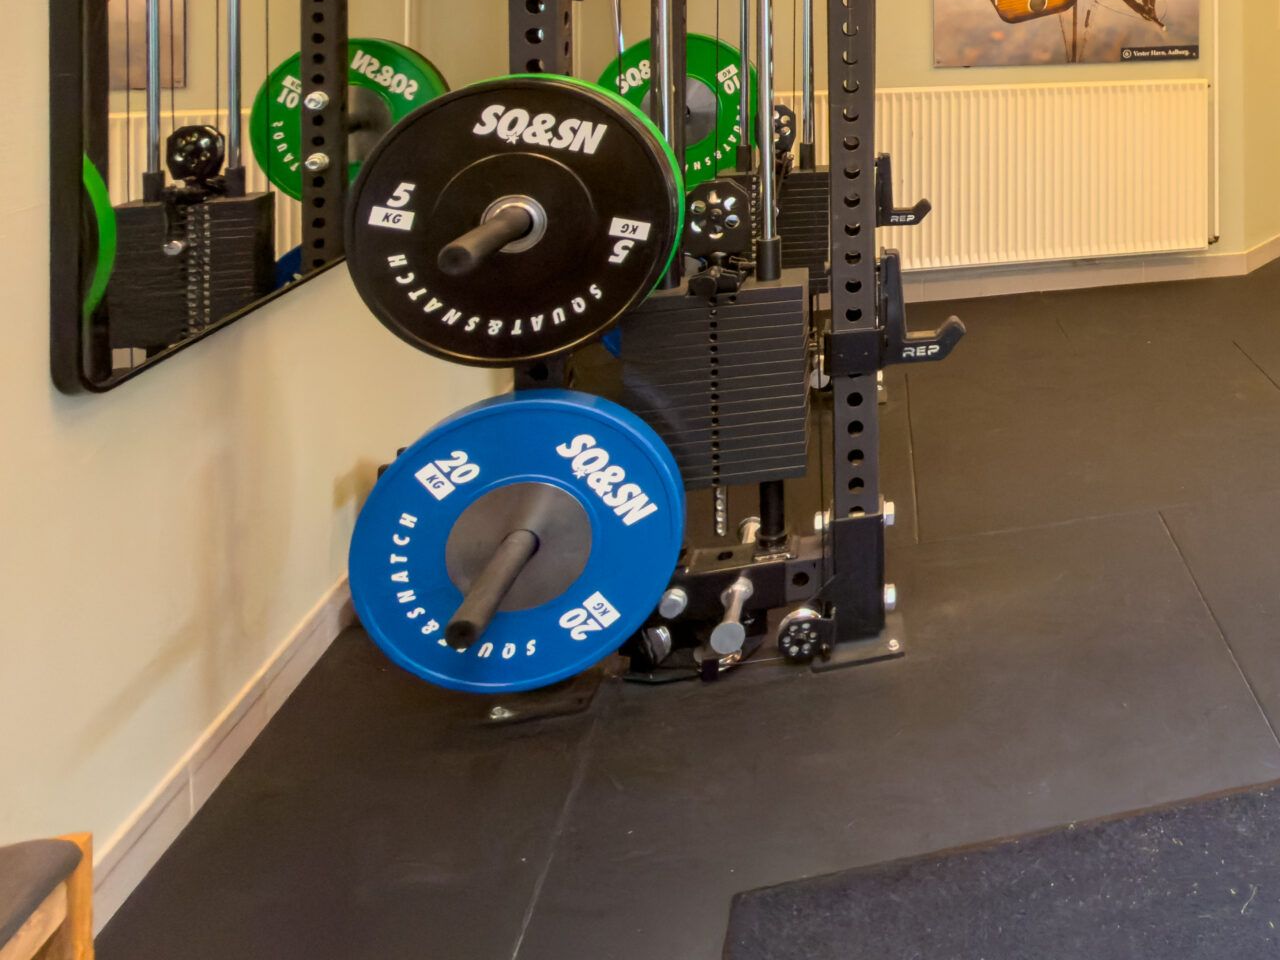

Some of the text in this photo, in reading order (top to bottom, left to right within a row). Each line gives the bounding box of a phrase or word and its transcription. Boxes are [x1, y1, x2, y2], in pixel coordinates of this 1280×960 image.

[472, 104, 607, 155] SQ&SN
[387, 182, 416, 208] 5
[381, 211, 402, 224] KG
[620, 222, 639, 235] KG
[890, 214, 915, 222] REP
[608, 239, 635, 264] 5
[902, 344, 940, 358] REP
[434, 450, 480, 484] 20
[555, 433, 658, 526] SQ&SN
[425, 473, 445, 491] KG
[389, 512, 537, 660] SQU&SNATCH
[592, 601, 612, 618] KG
[558, 607, 602, 641] 20
